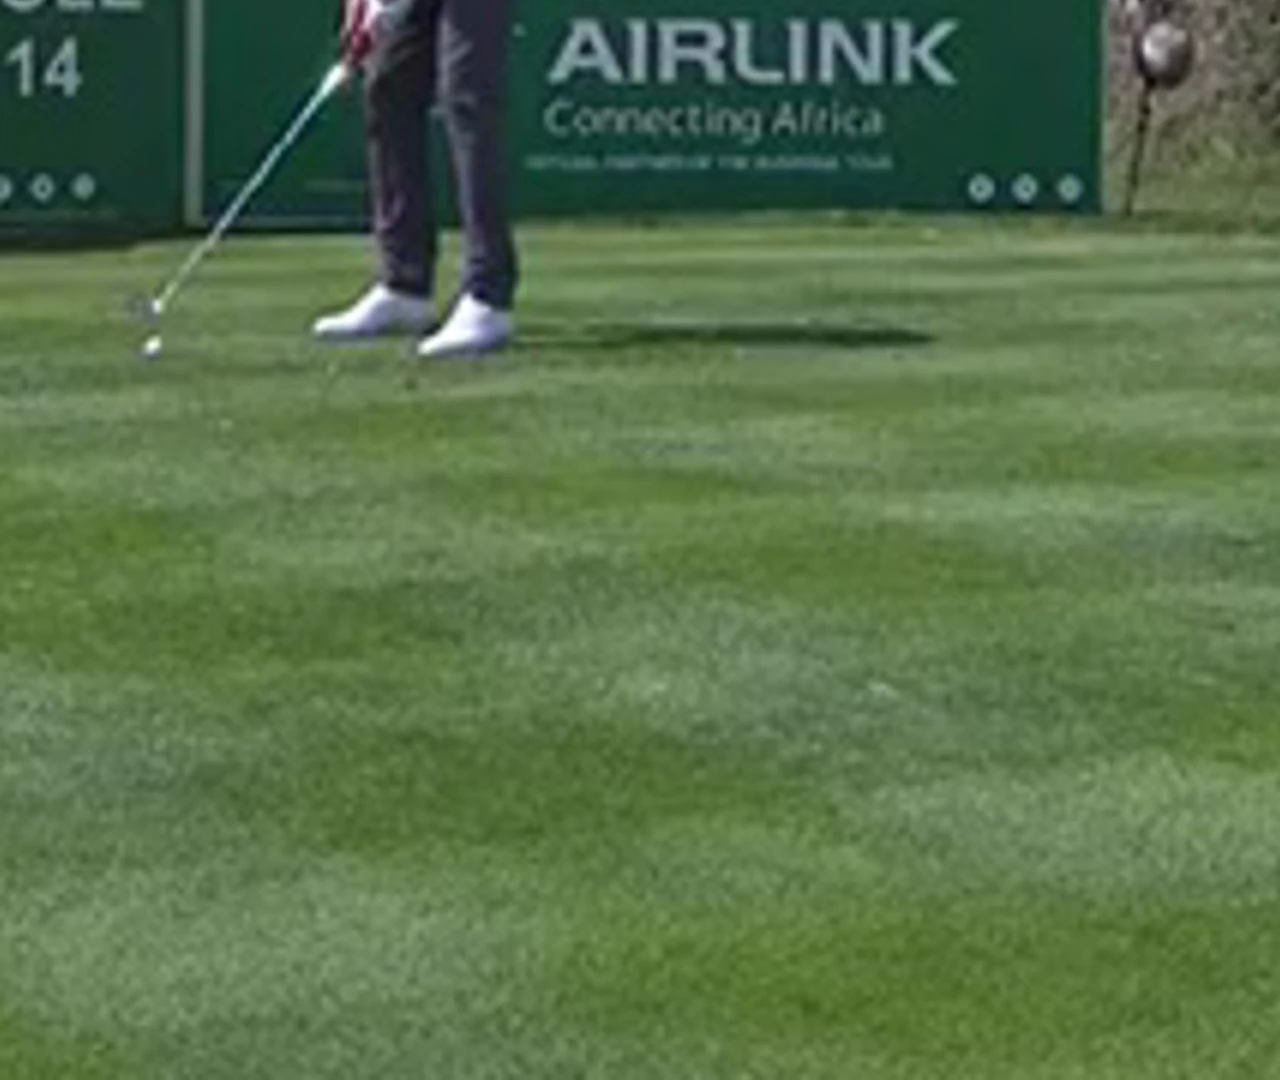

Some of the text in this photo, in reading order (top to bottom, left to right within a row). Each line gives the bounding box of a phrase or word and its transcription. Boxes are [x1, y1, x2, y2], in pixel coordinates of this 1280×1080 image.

[5, 35, 82, 98] 14
[547, 18, 960, 86] AIRLINK
[543, 98, 885, 142] Connecting Africa
